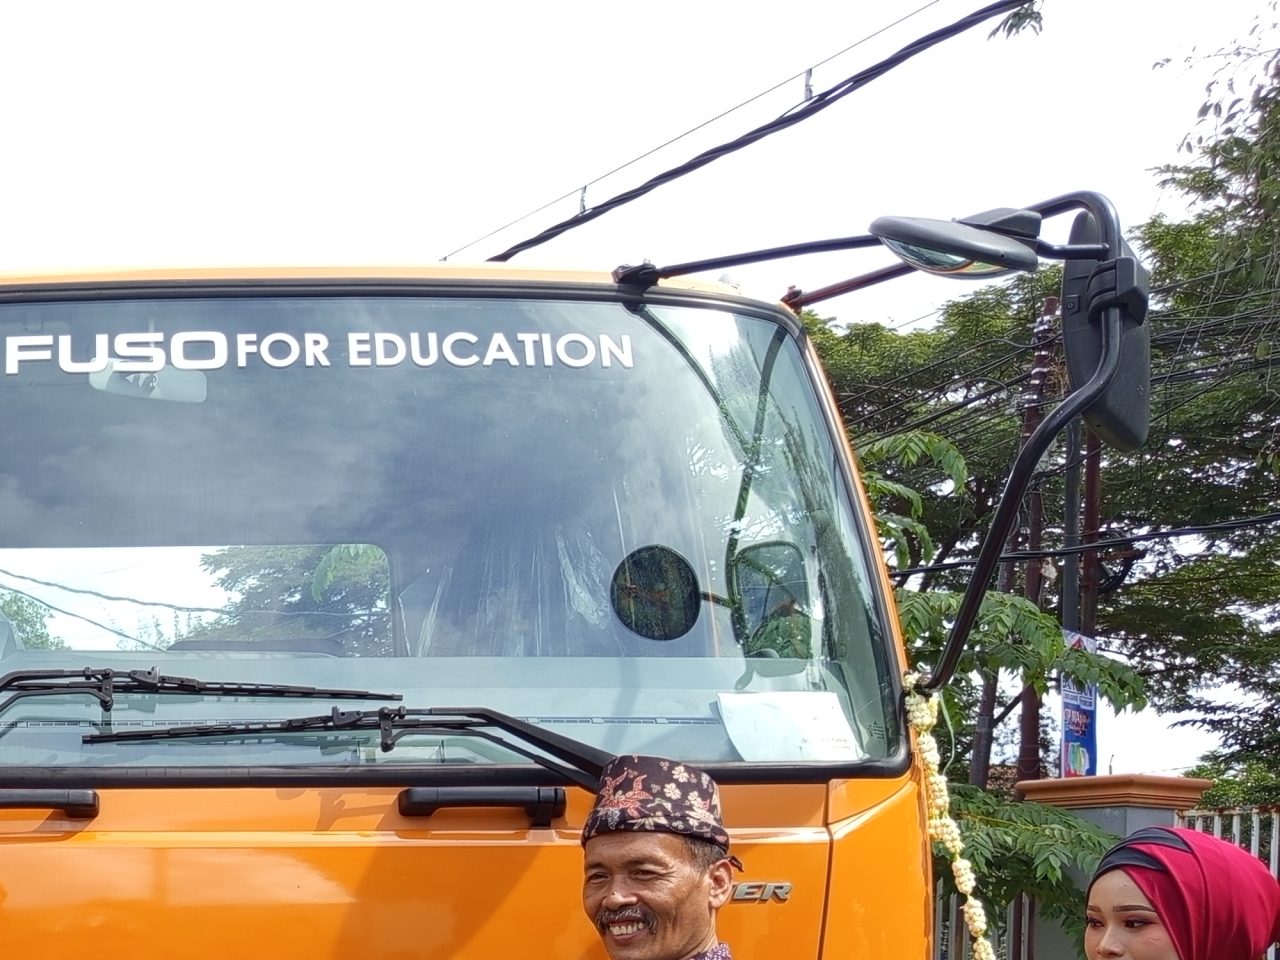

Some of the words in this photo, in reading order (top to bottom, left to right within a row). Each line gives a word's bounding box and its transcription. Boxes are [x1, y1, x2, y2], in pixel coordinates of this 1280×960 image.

[5, 331, 229, 374] FUSO
[236, 332, 331, 368] FOR
[347, 332, 634, 368] EDUCATION
[730, 882, 792, 903] ER
